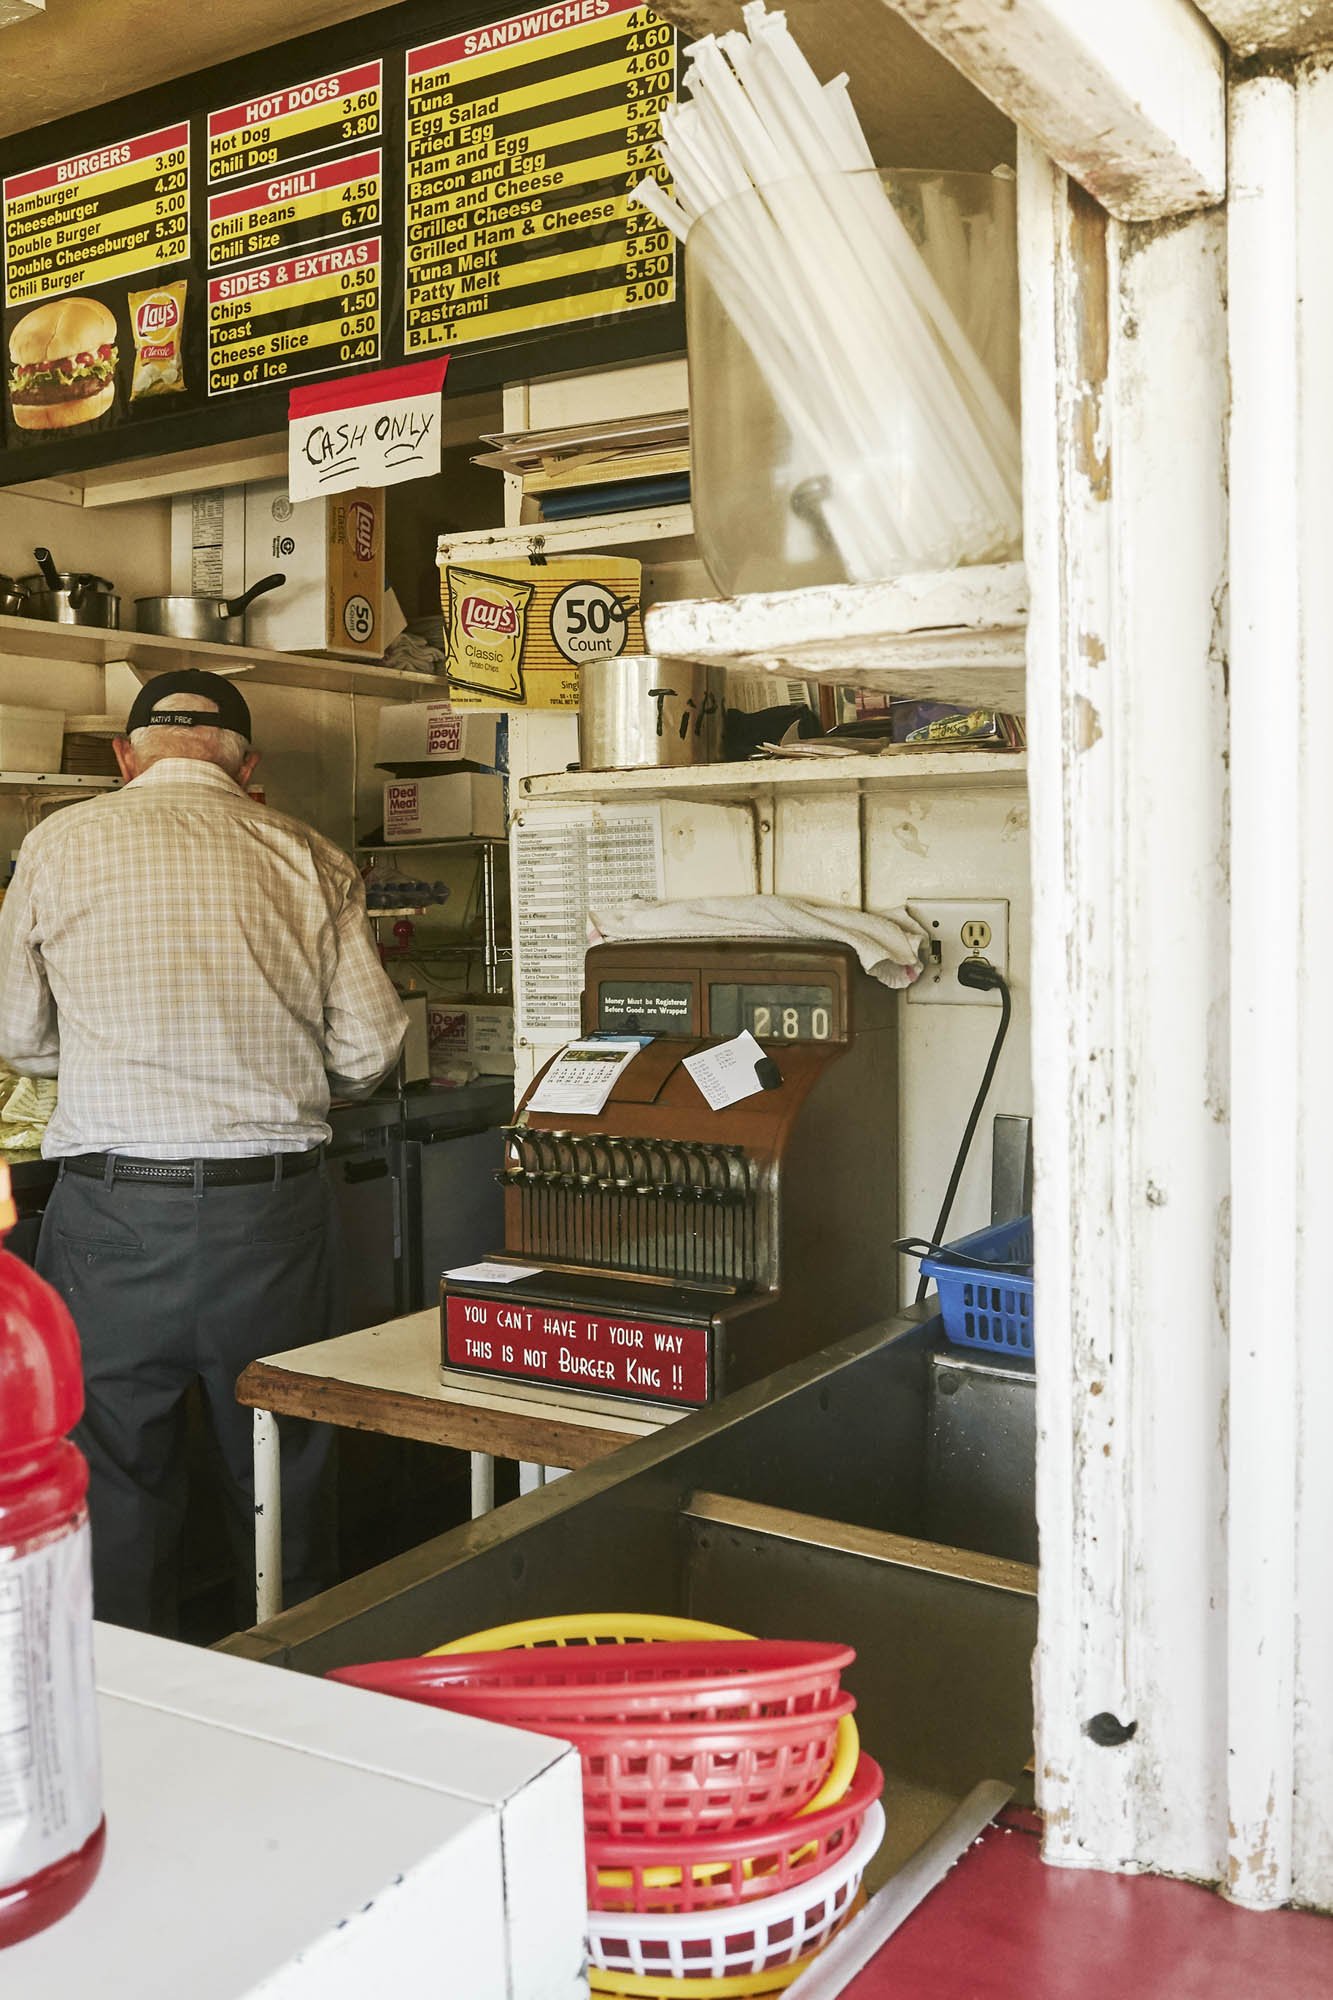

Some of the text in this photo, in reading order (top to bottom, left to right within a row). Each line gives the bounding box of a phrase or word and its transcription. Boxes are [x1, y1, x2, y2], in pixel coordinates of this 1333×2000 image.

[411, 9, 664, 94] Ham 4.6
[464, 0, 609, 55] SANDWICHES
[411, 26, 669, 115] Tuna 4.60
[411, 50, 669, 137] Egg Salad 4.60
[211, 92, 377, 154] Hot Dog 3.60
[246, 79, 339, 123] HOT DOGS
[411, 72, 669, 158] Fried Egg 3.70
[211, 117, 377, 178] Chili Dog 3.80
[411, 96, 669, 179] Ham and Egg 5.20
[8, 151, 185, 216] Hamburger 3.90
[57, 146, 130, 182] BURGERS
[268, 173, 316, 201] CHILI
[411, 177, 465, 199] Bacon
[471, 162, 504, 182] and
[510, 153, 545, 175] Egg
[8, 175, 185, 237] Cheeseburger 4.20
[211, 182, 377, 238] Chili Beans 4.50
[410, 218, 467, 240] Grilled
[474, 197, 542, 223] Cheese
[411, 201, 450, 221] Ham
[456, 188, 487, 206] and
[495, 171, 564, 199] Cheese
[8, 196, 185, 258] Double Burger 5.00
[9, 218, 185, 279] Double Cheeseburger 5.30
[211, 206, 377, 262] Chili Size 6.70
[410, 238, 466, 263] Grilled
[474, 225, 514, 247] Ham
[522, 217, 535, 235] &
[543, 203, 615, 231] Cheese
[9, 240, 185, 300] Chili Burger 4.20
[219, 246, 368, 297] SIDES & EXTRAS
[410, 257, 452, 283] Tuna
[458, 249, 497, 269] Melt
[410, 234, 668, 307] Patty Melt 5.50
[410, 256, 668, 325] Pastrami 5.50
[210, 293, 375, 343] Toast 1.50
[211, 269, 375, 321] Chips 0.50
[410, 280, 668, 347] B.L.T. 5.00
[211, 317, 375, 366] Cheese Slice 0.50
[211, 341, 375, 391] Cup of Ice 0.40
[303, 414, 434, 465] CASH ONLY
[356, 606, 368, 633] 50
[466, 599, 512, 629] Lay's
[566, 599, 610, 634] 50
[465, 645, 503, 662] Classic
[469, 660, 499, 672] Potato Chips
[568, 637, 612, 652] Count
[430, 729, 459, 740] Meat
[390, 798, 416, 809] Meat
[605, 997, 687, 1007] Money Must be Registered
[626, 1006, 645, 1014] Goods
[660, 1006, 687, 1016] Wrapped
[464, 1306, 683, 1354] YOU CAN'T HAVE IT YOUR WAY
[465, 1339, 492, 1359] THIS
[502, 1345, 513, 1363] IS
[524, 1348, 547, 1368] NOT
